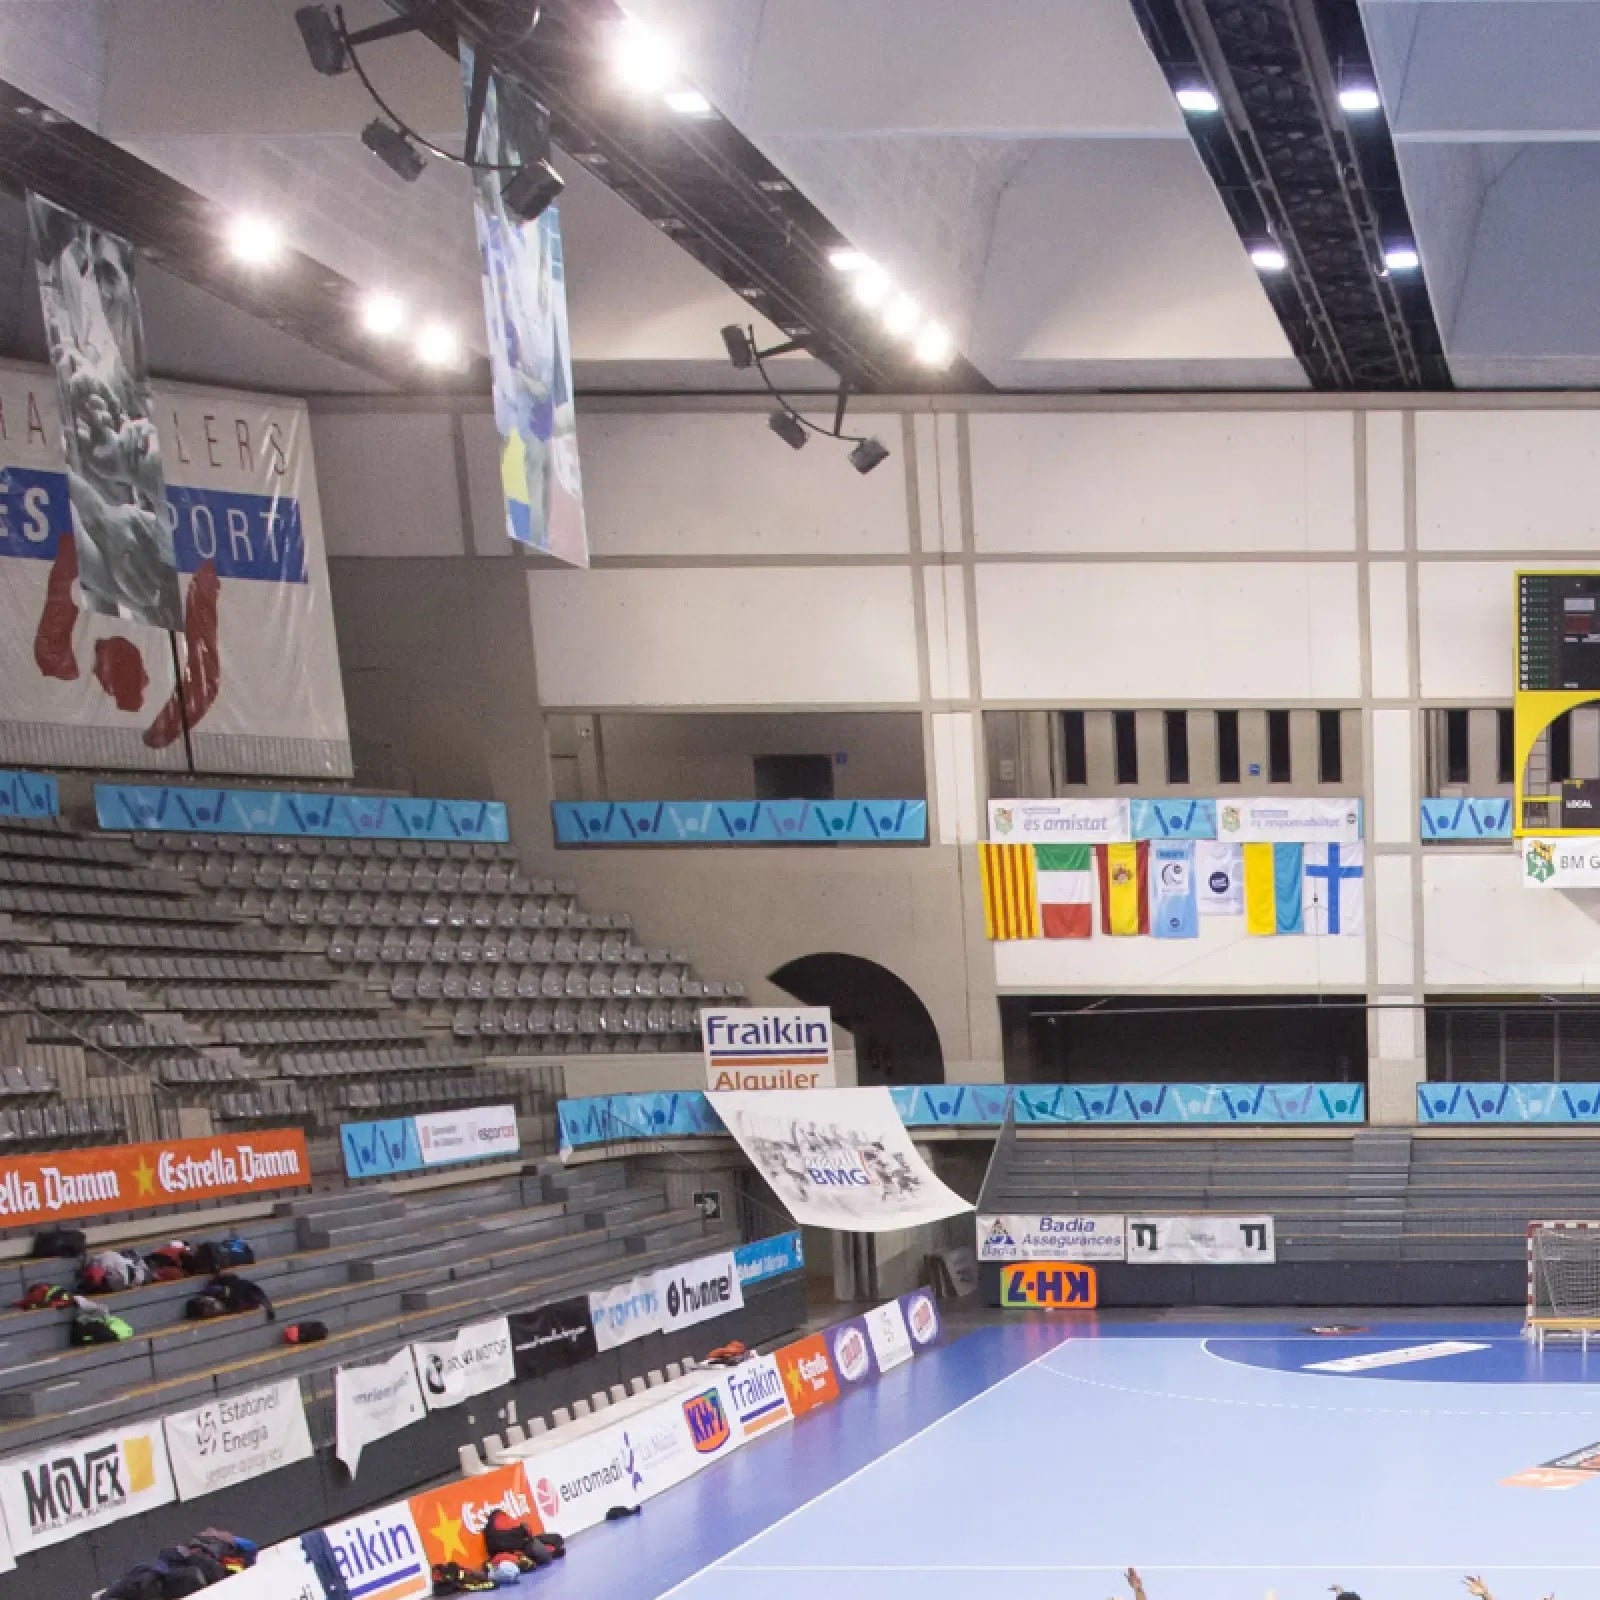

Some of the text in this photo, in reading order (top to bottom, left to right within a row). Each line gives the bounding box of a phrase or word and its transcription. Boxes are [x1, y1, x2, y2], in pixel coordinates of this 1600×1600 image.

[1560, 855, 1584, 869] BM
[707, 1016, 828, 1045] Fraikin
[158, 1145, 299, 1192] Estrella Damm
[807, 1168, 871, 1185] BMG
[40, 1167, 118, 1210] Damm
[1023, 1232, 1121, 1248] Assegurances
[1040, 1217, 1095, 1233] Badia
[1007, 1271, 1089, 1303] KH-7
[727, 1366, 781, 1411] Fraikin
[560, 1460, 624, 1502] euromadi
[334, 1519, 416, 1578] aikin
